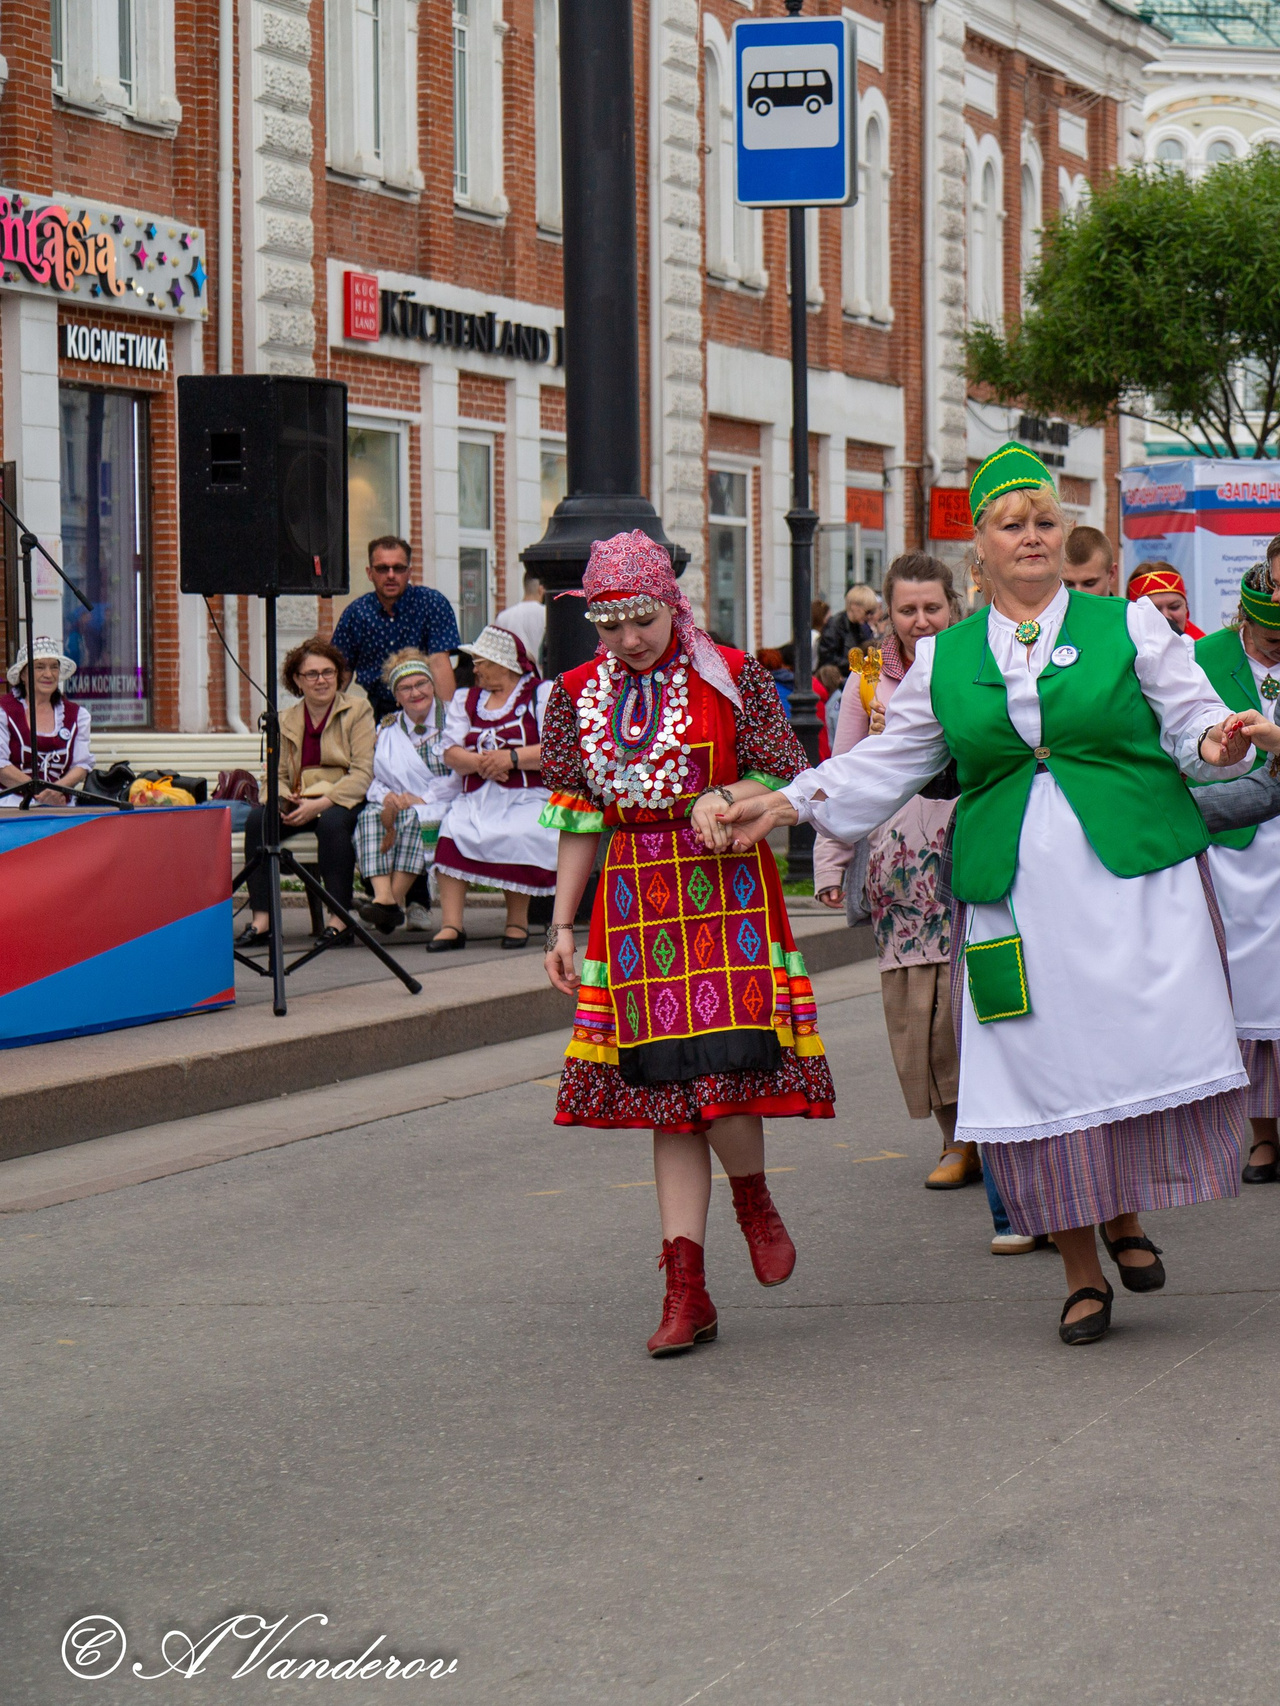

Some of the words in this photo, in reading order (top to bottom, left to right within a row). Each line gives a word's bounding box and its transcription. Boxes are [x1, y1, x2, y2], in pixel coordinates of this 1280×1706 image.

[355, 315, 376, 331] LAND
[66, 324, 169, 371] КОСМЕТИКА
[91, 674, 145, 694] КОСМЕТИКА
